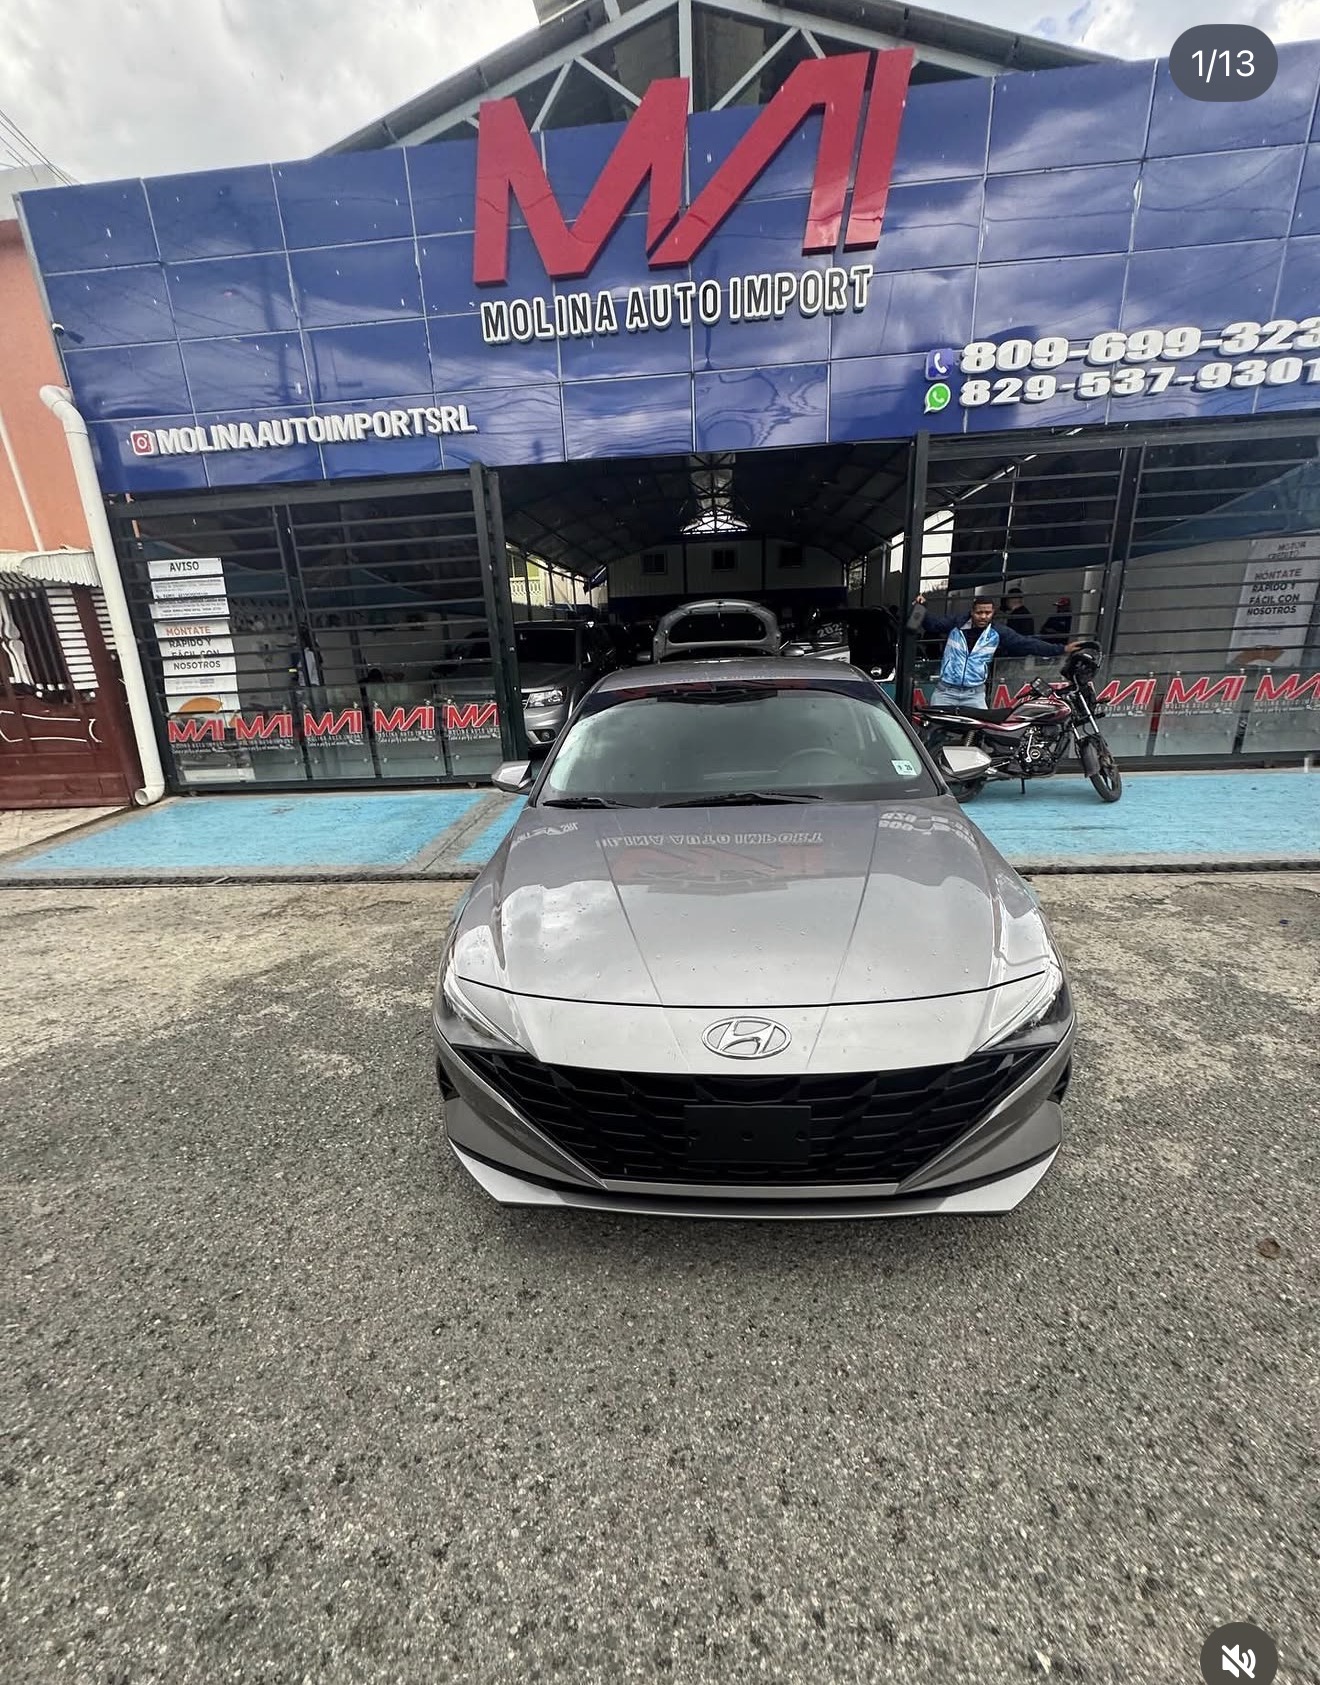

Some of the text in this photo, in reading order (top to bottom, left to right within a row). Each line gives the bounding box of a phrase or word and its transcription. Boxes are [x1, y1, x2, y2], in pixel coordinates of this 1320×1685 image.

[480, 264, 873, 344] MOLINA AUTO IMPORT
[155, 404, 478, 455] MOLINAAUTOIMPORTSRL
[169, 561, 200, 573] AVISO
[1277, 593, 1300, 604] CON
[1246, 605, 1297, 616] NOSOTROS
[173, 660, 221, 671] NOSOTROS
